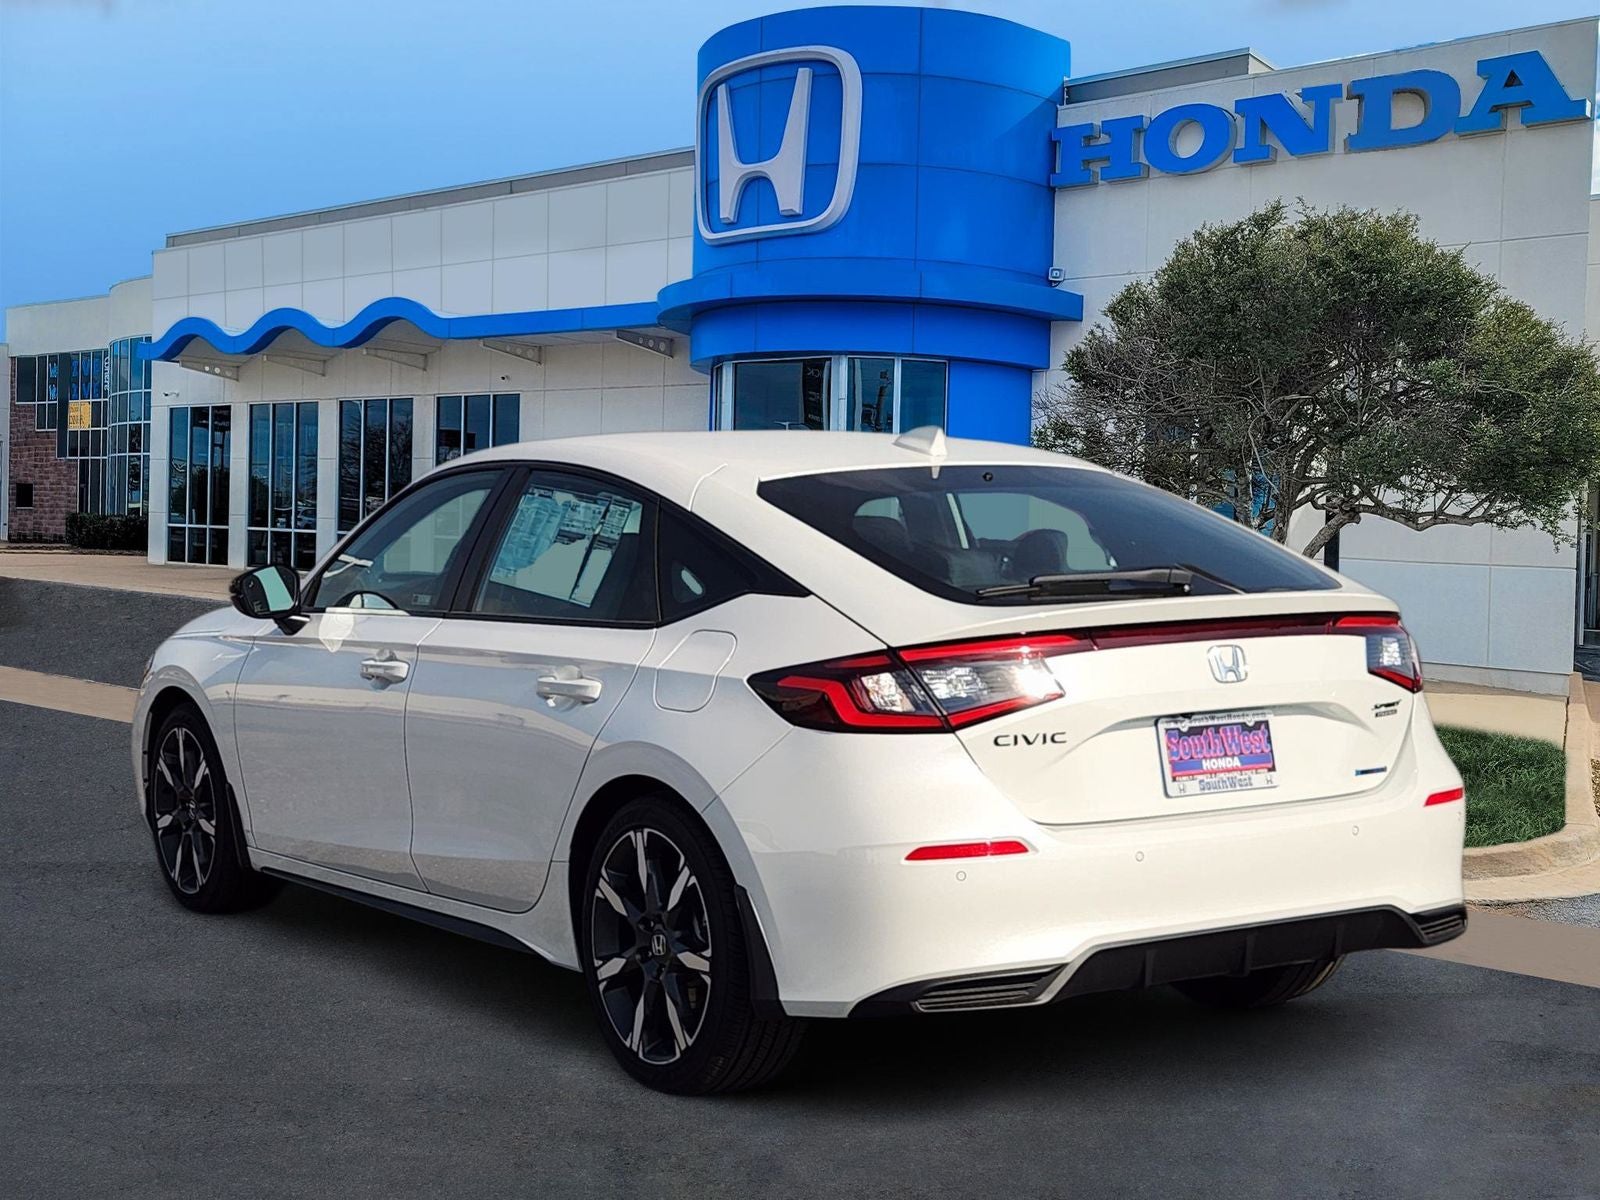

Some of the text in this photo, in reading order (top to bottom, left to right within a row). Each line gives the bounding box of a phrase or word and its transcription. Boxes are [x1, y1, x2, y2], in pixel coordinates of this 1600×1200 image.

[1050, 49, 1591, 188] HONDA
[993, 731, 1068, 747] CIVIC
[1166, 725, 1271, 761] SouthWest
[1202, 756, 1242, 771] HONDA
